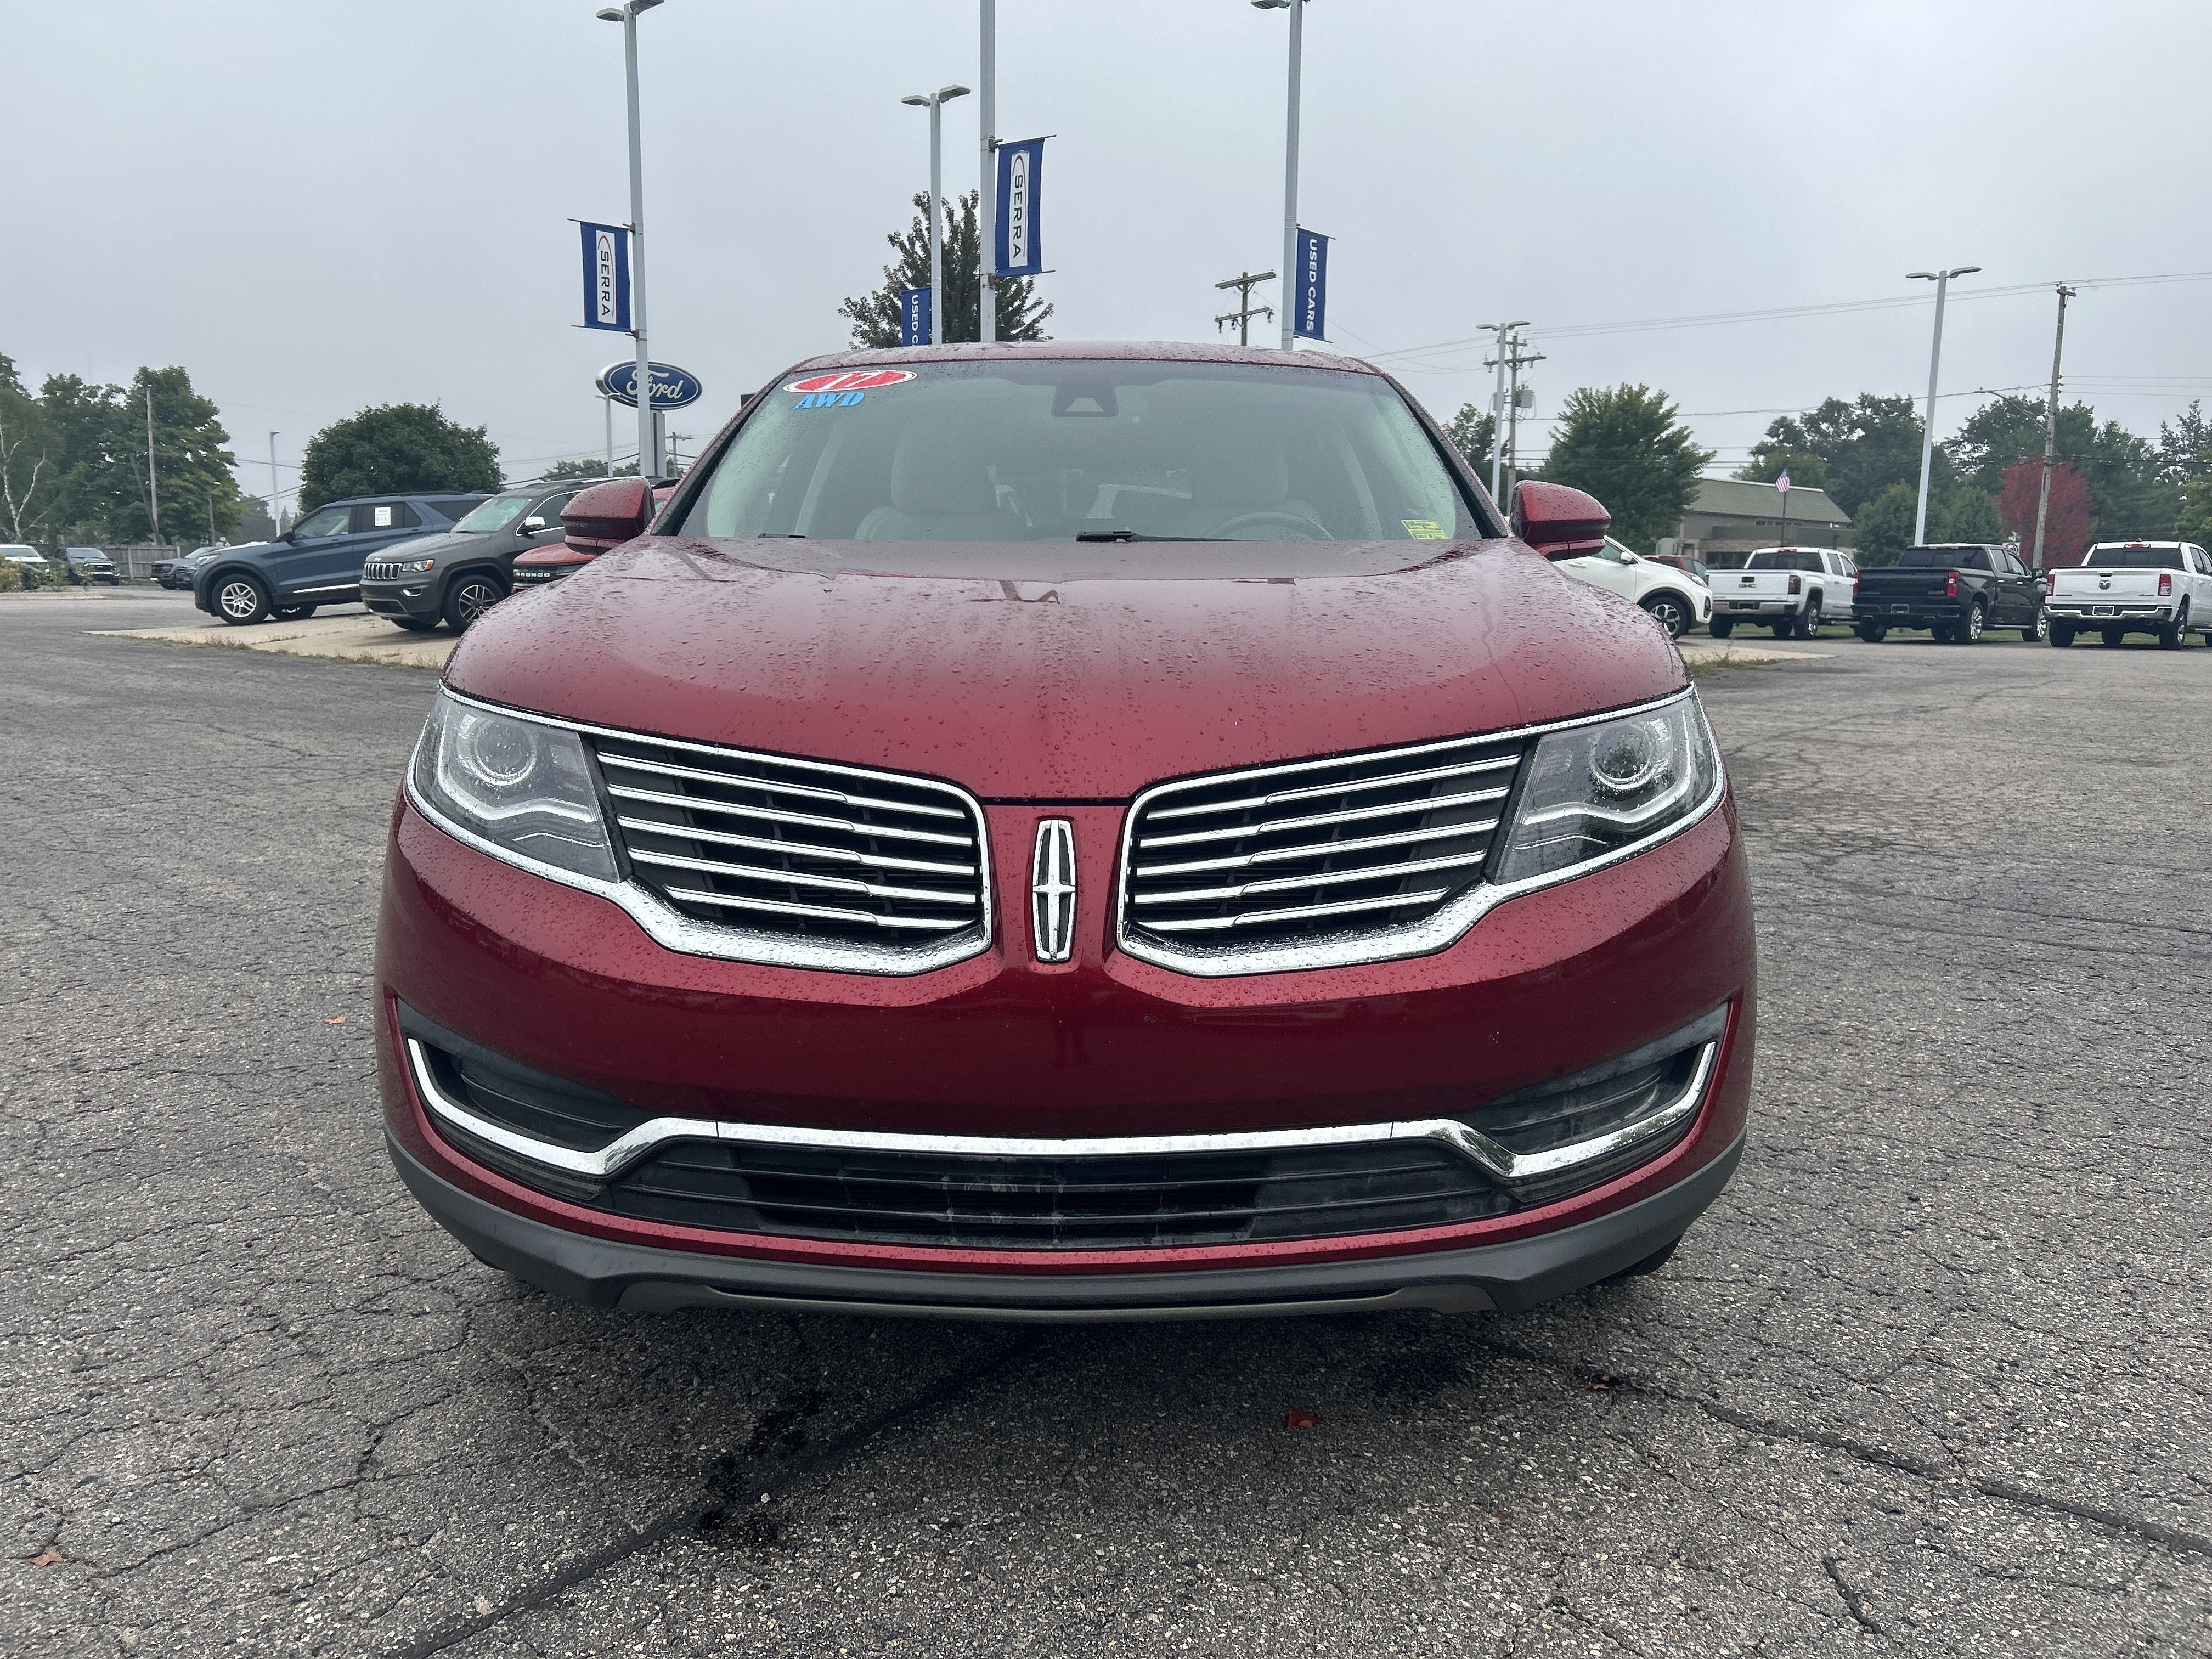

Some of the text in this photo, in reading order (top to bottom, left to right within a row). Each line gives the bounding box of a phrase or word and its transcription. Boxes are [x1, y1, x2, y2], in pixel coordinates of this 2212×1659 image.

[1013, 174, 1023, 259] SERRA
[601, 250, 610, 317] SERRA
[1306, 239, 1317, 331] USED CARS
[793, 391, 865, 409] AWD
[819, 370, 889, 390] 17
